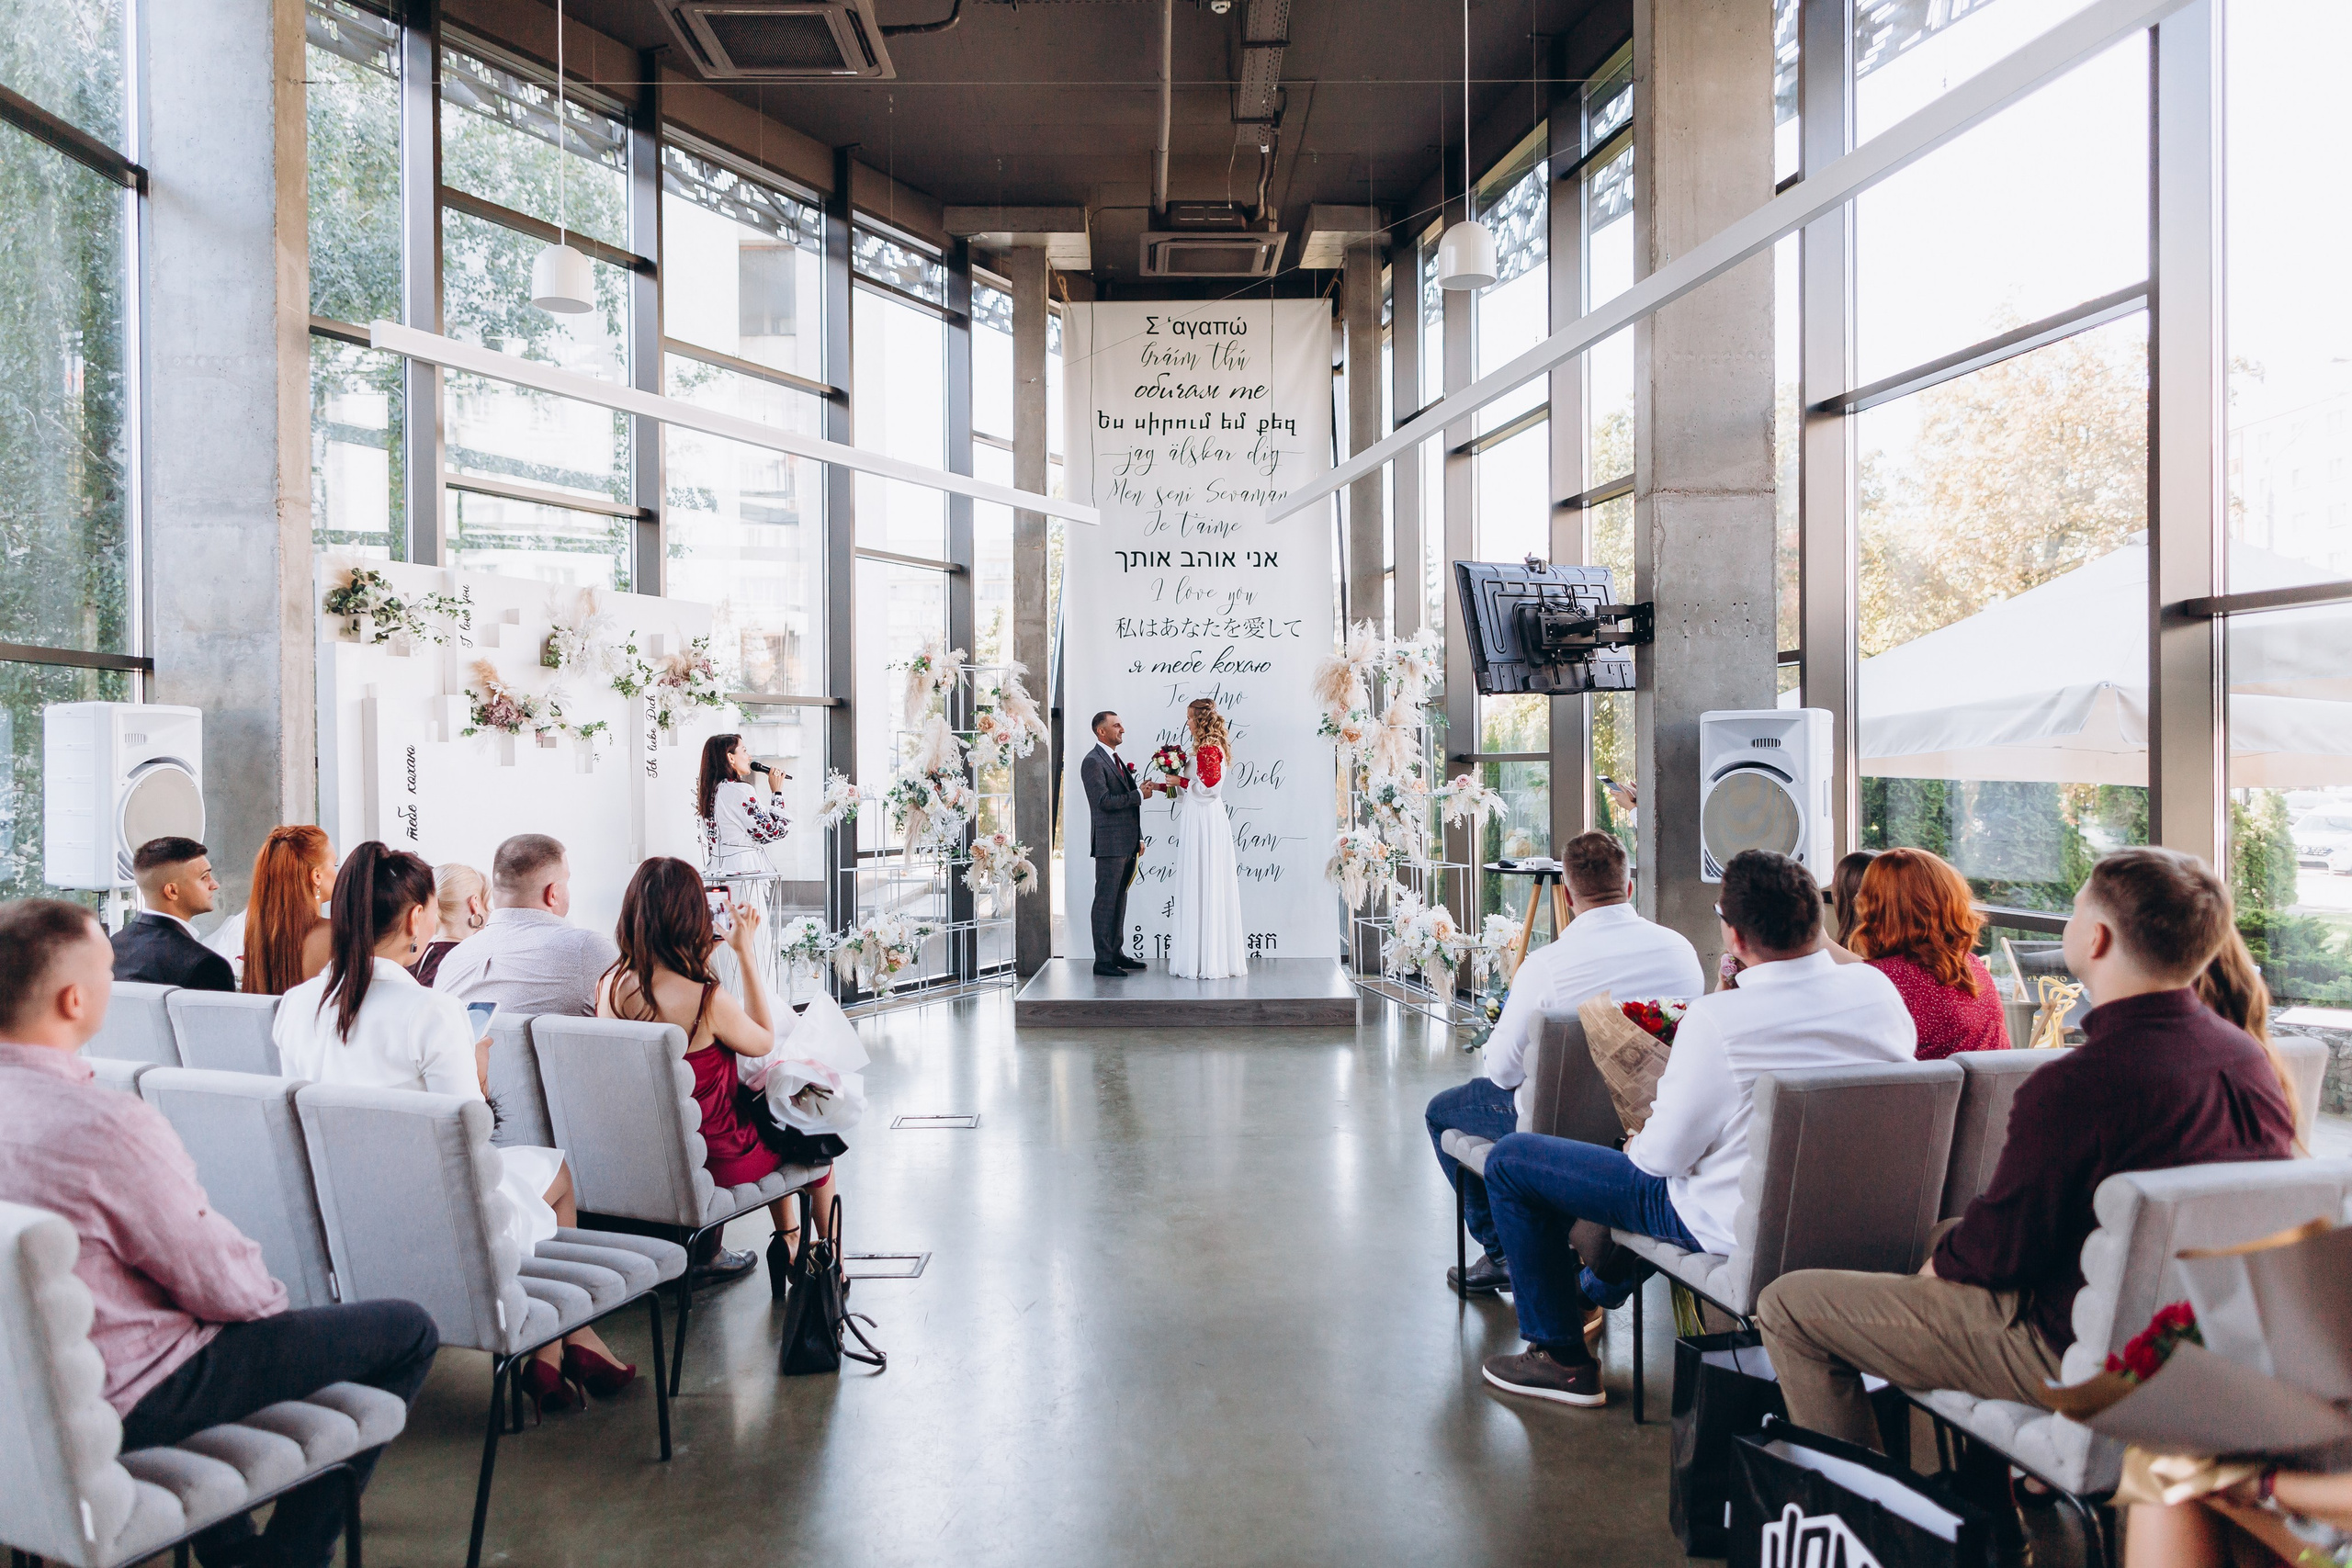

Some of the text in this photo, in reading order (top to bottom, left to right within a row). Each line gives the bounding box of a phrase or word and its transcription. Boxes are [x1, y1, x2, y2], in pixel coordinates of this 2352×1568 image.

[1146, 316, 1159, 335] Σ
[1169, 435, 1237, 468] älskar
[1143, 509, 1171, 537] Je
[1114, 551, 1279, 573] אני אוהב אותך
[462, 583, 475, 606] you
[1150, 575, 1259, 616] I love you
[1114, 616, 1303, 639] 私はあなたを愛して
[1128, 645, 1272, 675] я тебе кохаю
[1163, 681, 1190, 708] Te
[1231, 760, 1286, 790] Dich
